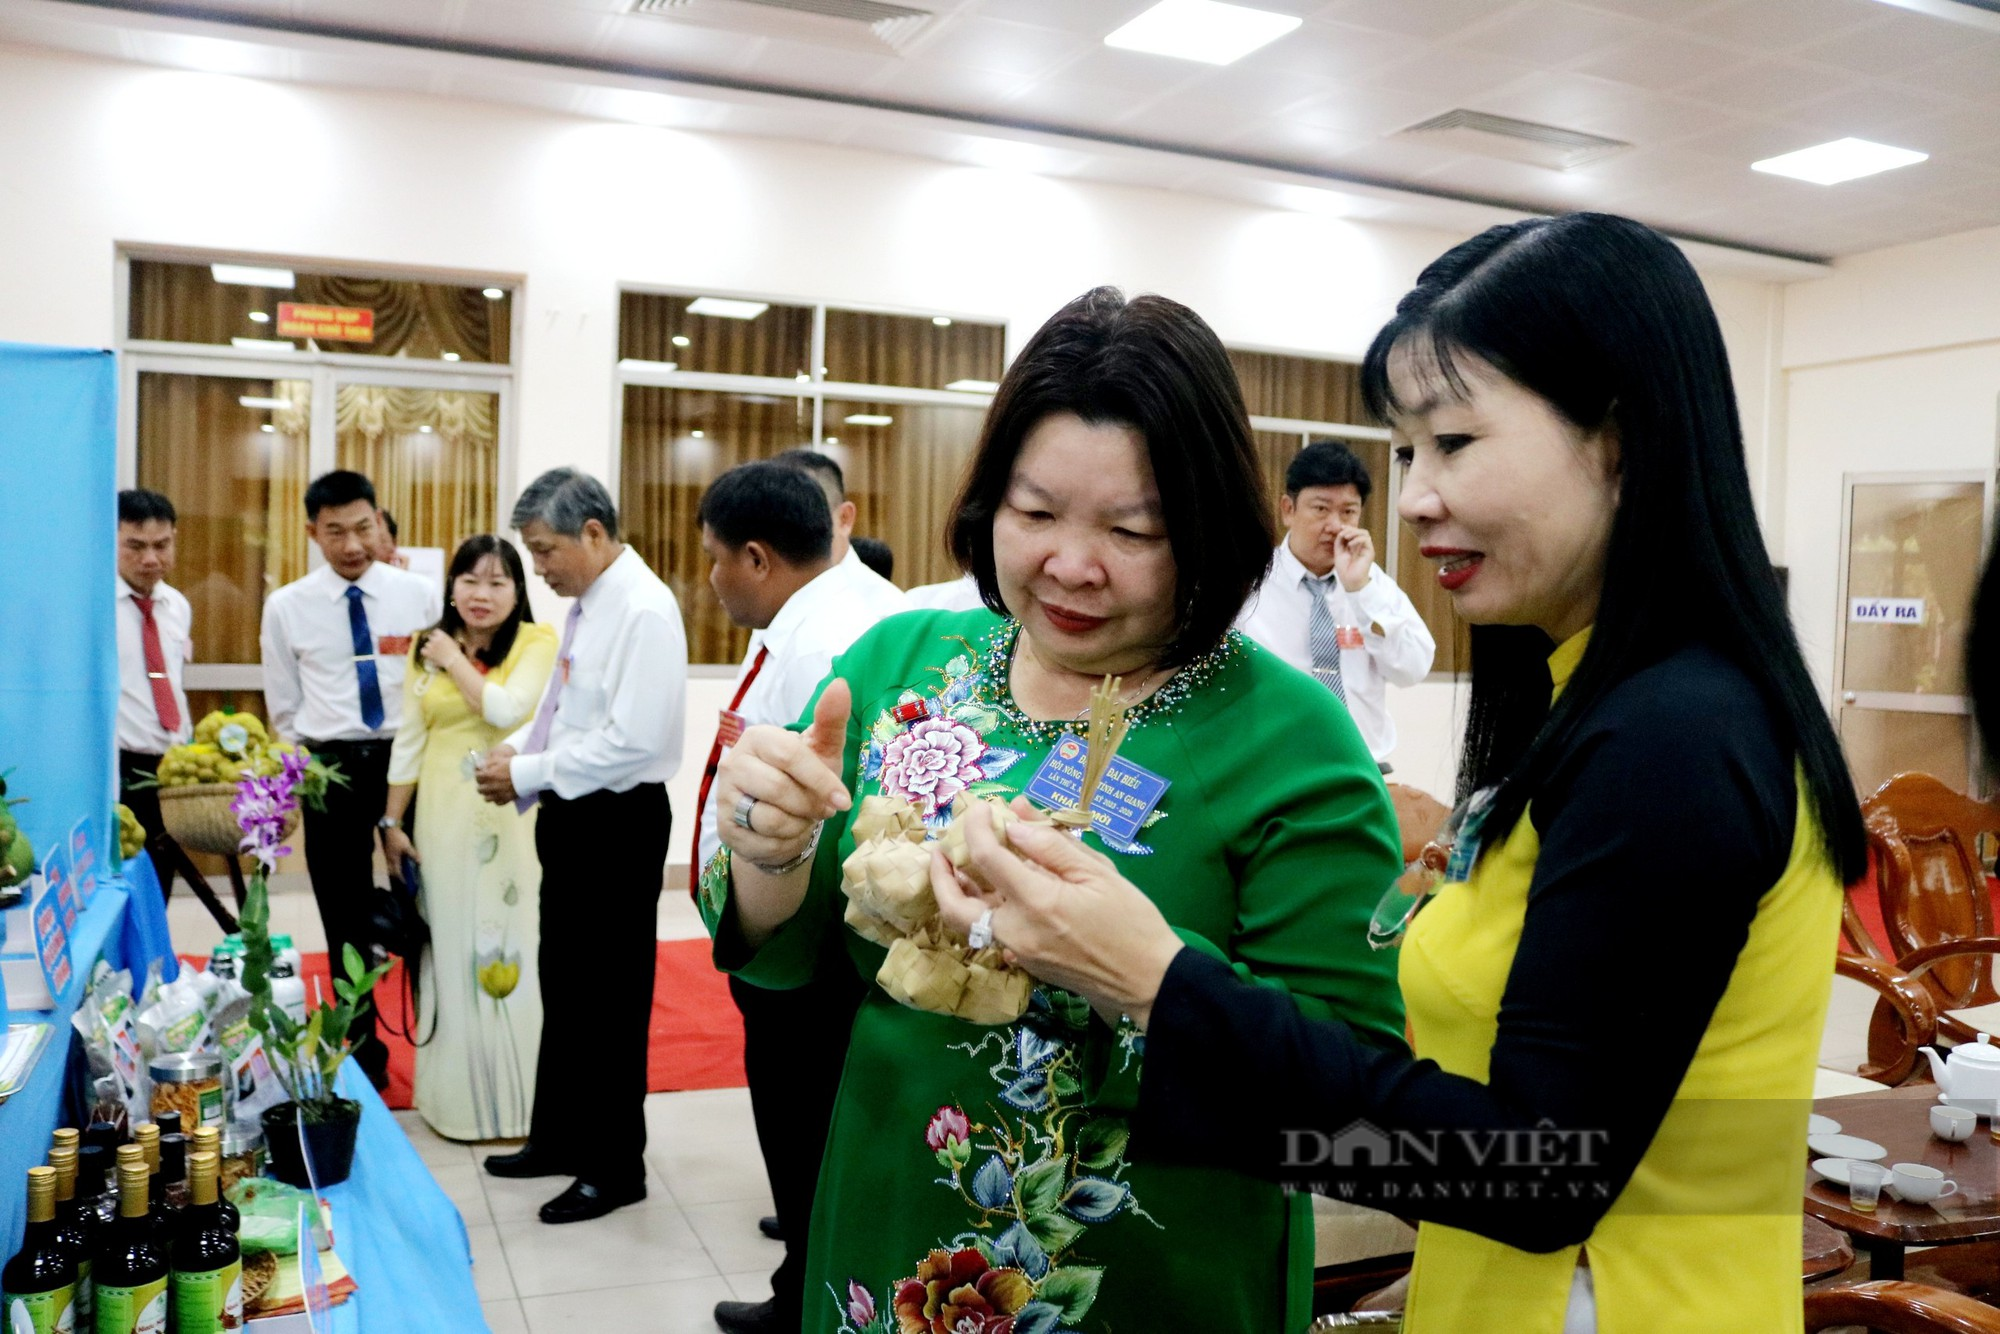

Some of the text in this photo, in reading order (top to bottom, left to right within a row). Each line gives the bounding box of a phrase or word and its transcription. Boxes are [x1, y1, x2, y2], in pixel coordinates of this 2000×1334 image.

[1895, 607, 1917, 618] RA
[1049, 759, 1064, 771] HỘI
[1061, 765, 1082, 780] NÔNG
[1112, 790, 1125, 799] AN
[1123, 794, 1147, 810] GIANG
[1105, 767, 1123, 781] ĐẠI
[1120, 773, 1142, 790] BIỂU
[1050, 791, 1080, 810] KHÁC
